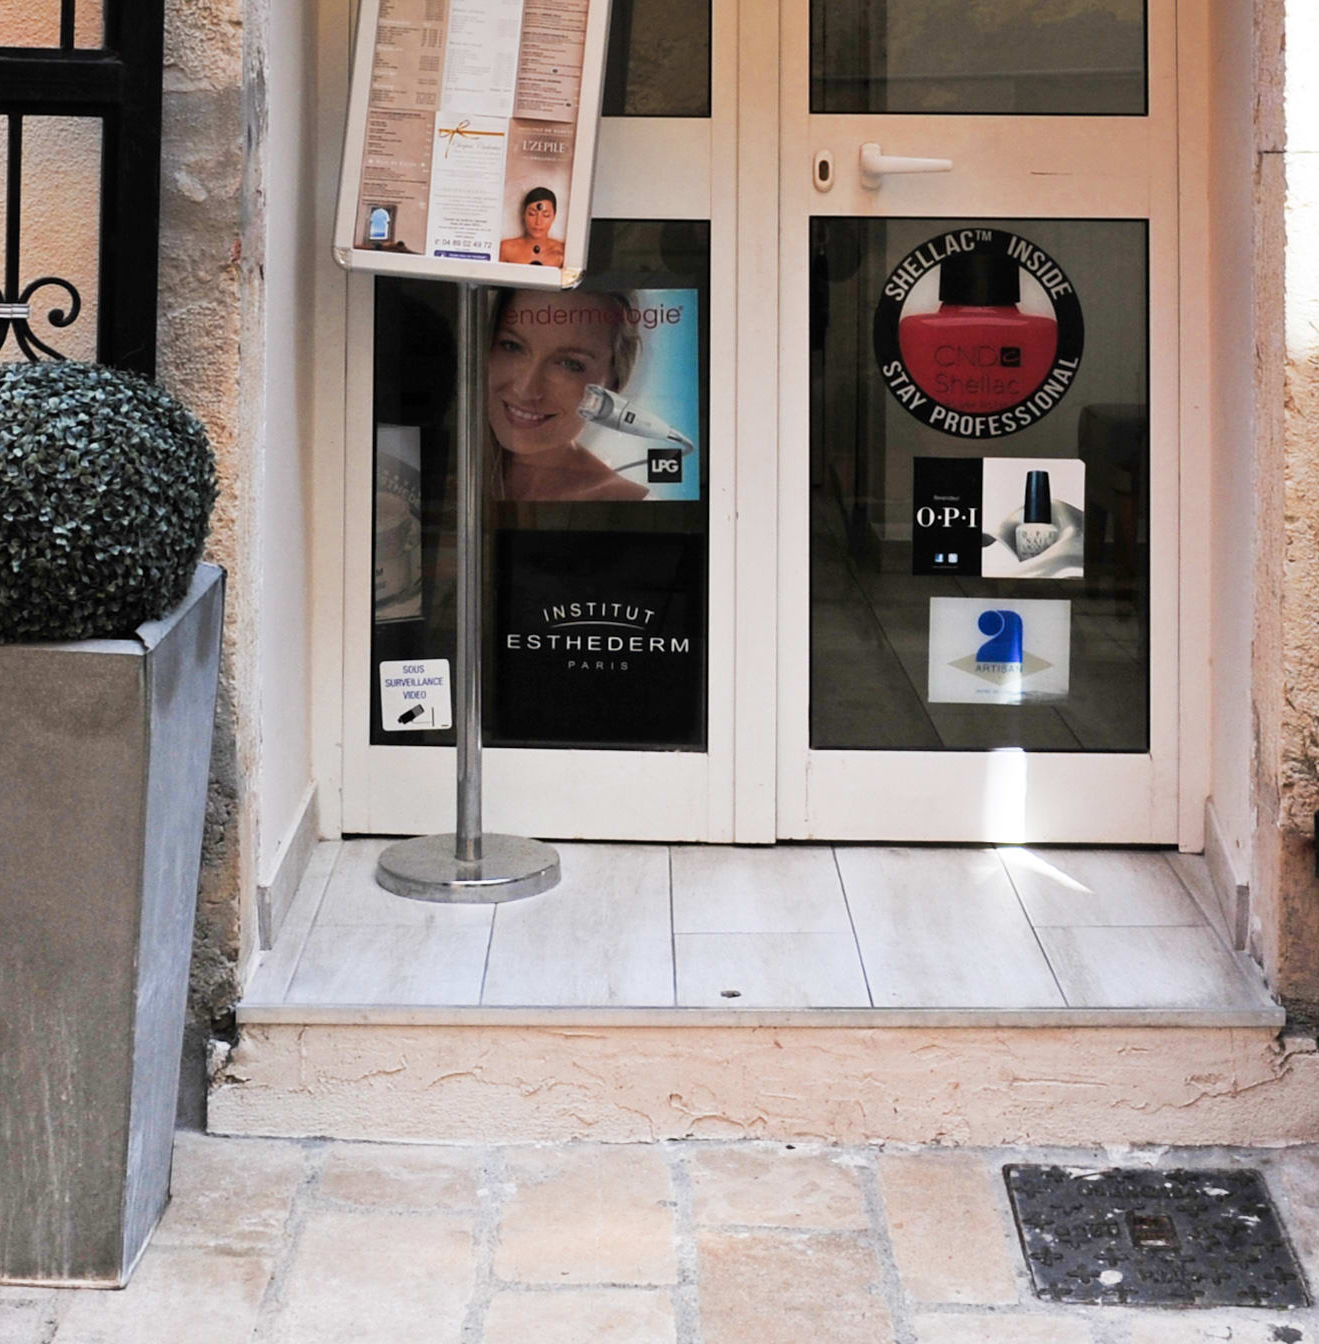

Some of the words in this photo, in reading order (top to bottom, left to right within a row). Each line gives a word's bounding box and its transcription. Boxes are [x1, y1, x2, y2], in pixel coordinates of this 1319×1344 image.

[1007, 235, 1073, 300] INSIDE
[883, 360, 927, 411] STAY
[929, 357, 1079, 437] PROFESSIONAL
[651, 459, 679, 473] LPG
[543, 602, 655, 624] INSTITUT
[506, 634, 690, 653] ESTHEDERM
[403, 664, 425, 674] SOUS
[568, 660, 629, 671] PARIS
[385, 676, 443, 688] SURVEILLANCE
